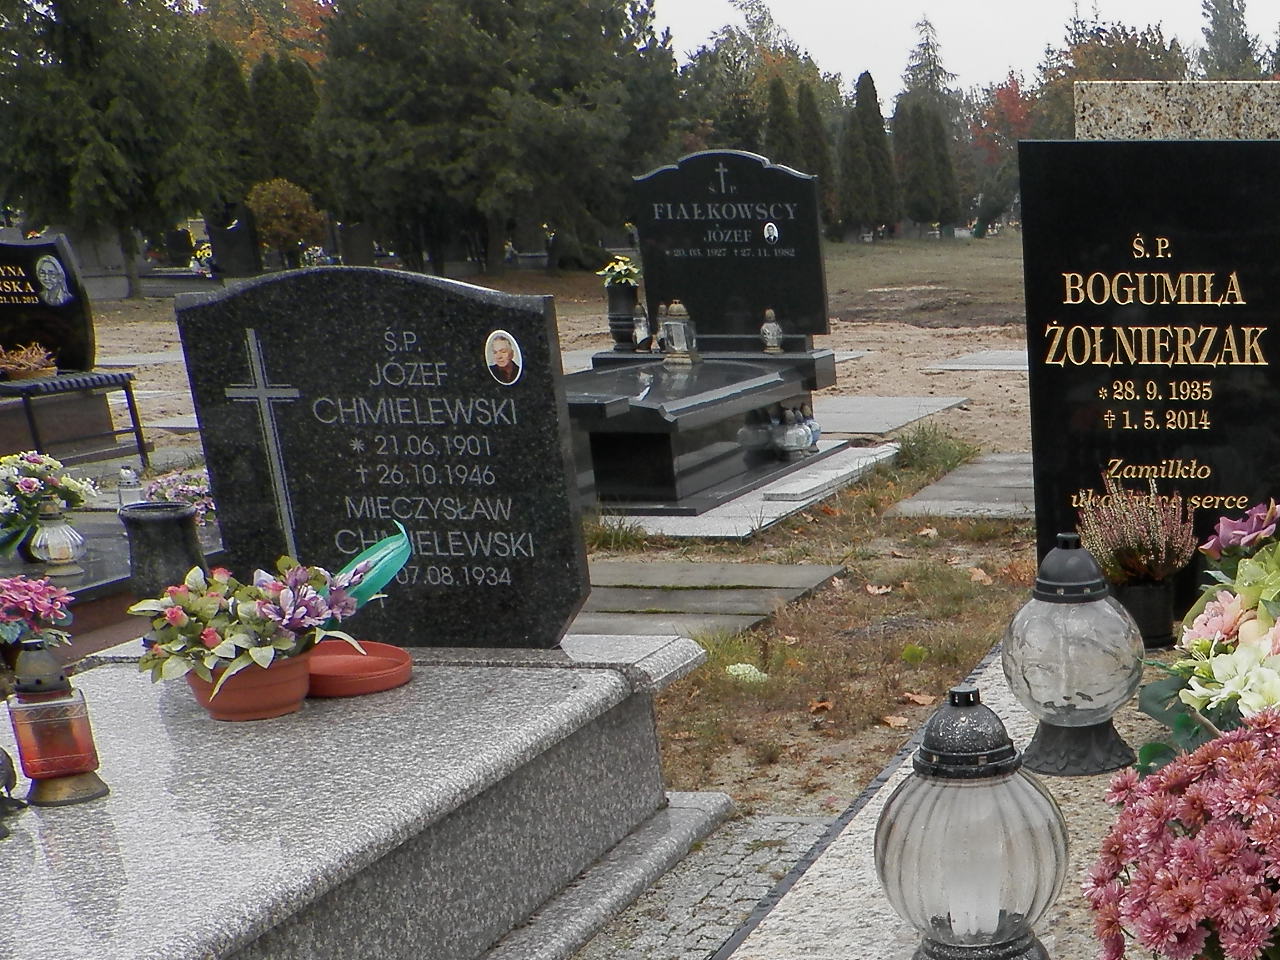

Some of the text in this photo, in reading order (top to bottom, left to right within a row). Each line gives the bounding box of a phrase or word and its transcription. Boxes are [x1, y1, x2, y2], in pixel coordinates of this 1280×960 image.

[653, 203, 798, 220] FIAŁKOWSCY
[703, 224, 752, 242] JÓZEF
[1155, 237, 1172, 259] P.
[0, 280, 35, 293] SKA
[1061, 271, 1247, 307] BOGUMIŁA
[1045, 320, 1269, 368] ŻOŁNIERZAK
[369, 357, 448, 386] JÓZEF
[1113, 380, 1213, 401] 28. 9. 1935
[312, 397, 518, 425] CHMIELEWSKI
[1122, 410, 1211, 430] 1. 5. 2014
[374, 435, 491, 456] 21.06.1901
[376, 464, 496, 485] 26.10.1946
[1107, 458, 1212, 479] Zamilkło
[344, 496, 512, 521] MIECZYSŁAW
[1190, 495, 1249, 510] serce
[335, 529, 535, 557] CHIELEWSKI
